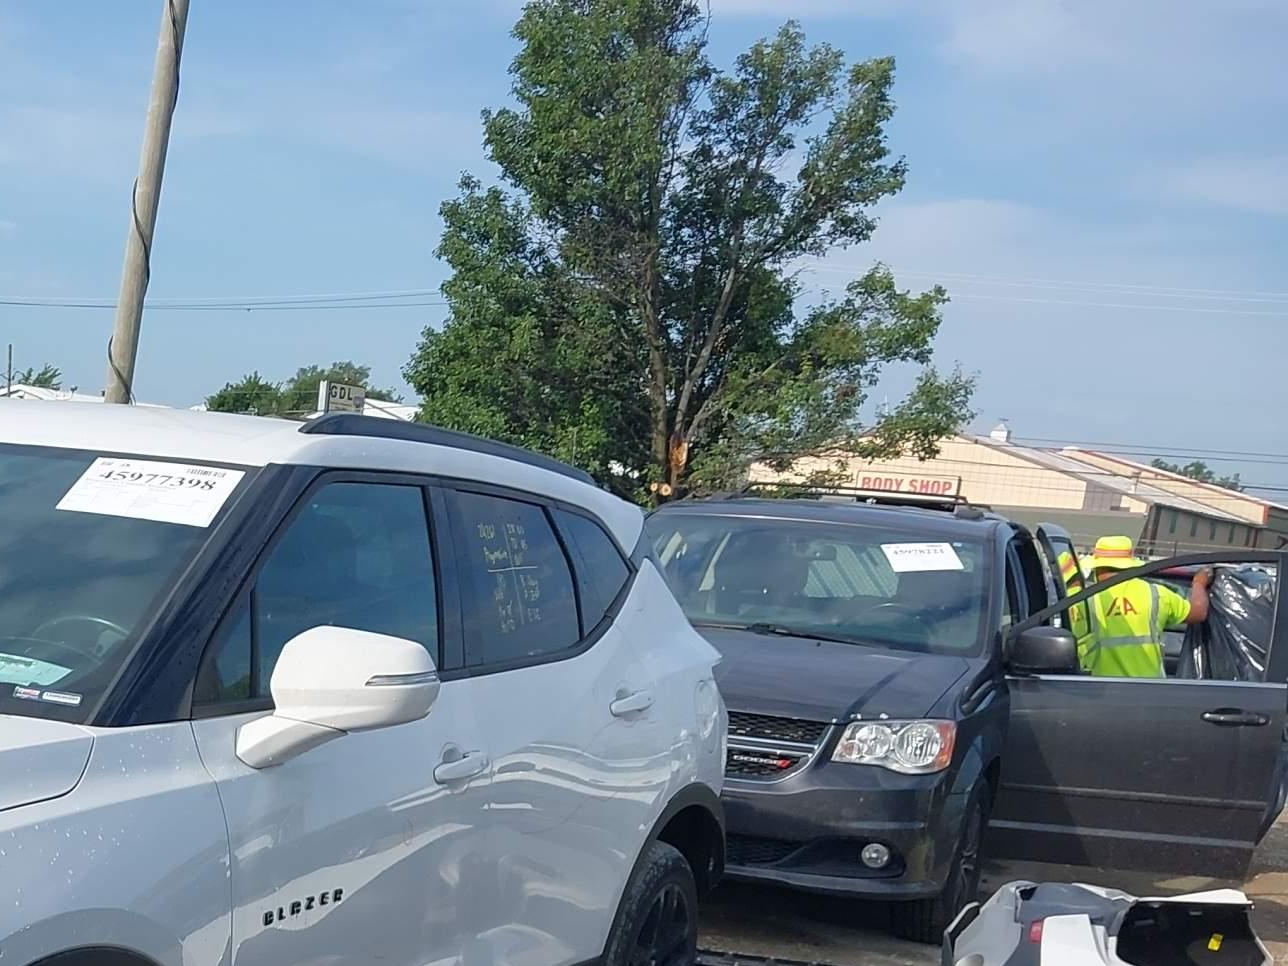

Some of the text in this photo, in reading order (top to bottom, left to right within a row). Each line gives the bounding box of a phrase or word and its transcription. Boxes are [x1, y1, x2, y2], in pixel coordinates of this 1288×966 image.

[330, 384, 353, 401] GDL
[99, 469, 218, 492] 45977398
[861, 476, 953, 494] BODY SHOP
[732, 754, 779, 765] DODGE
[262, 888, 344, 926] BLAZER
